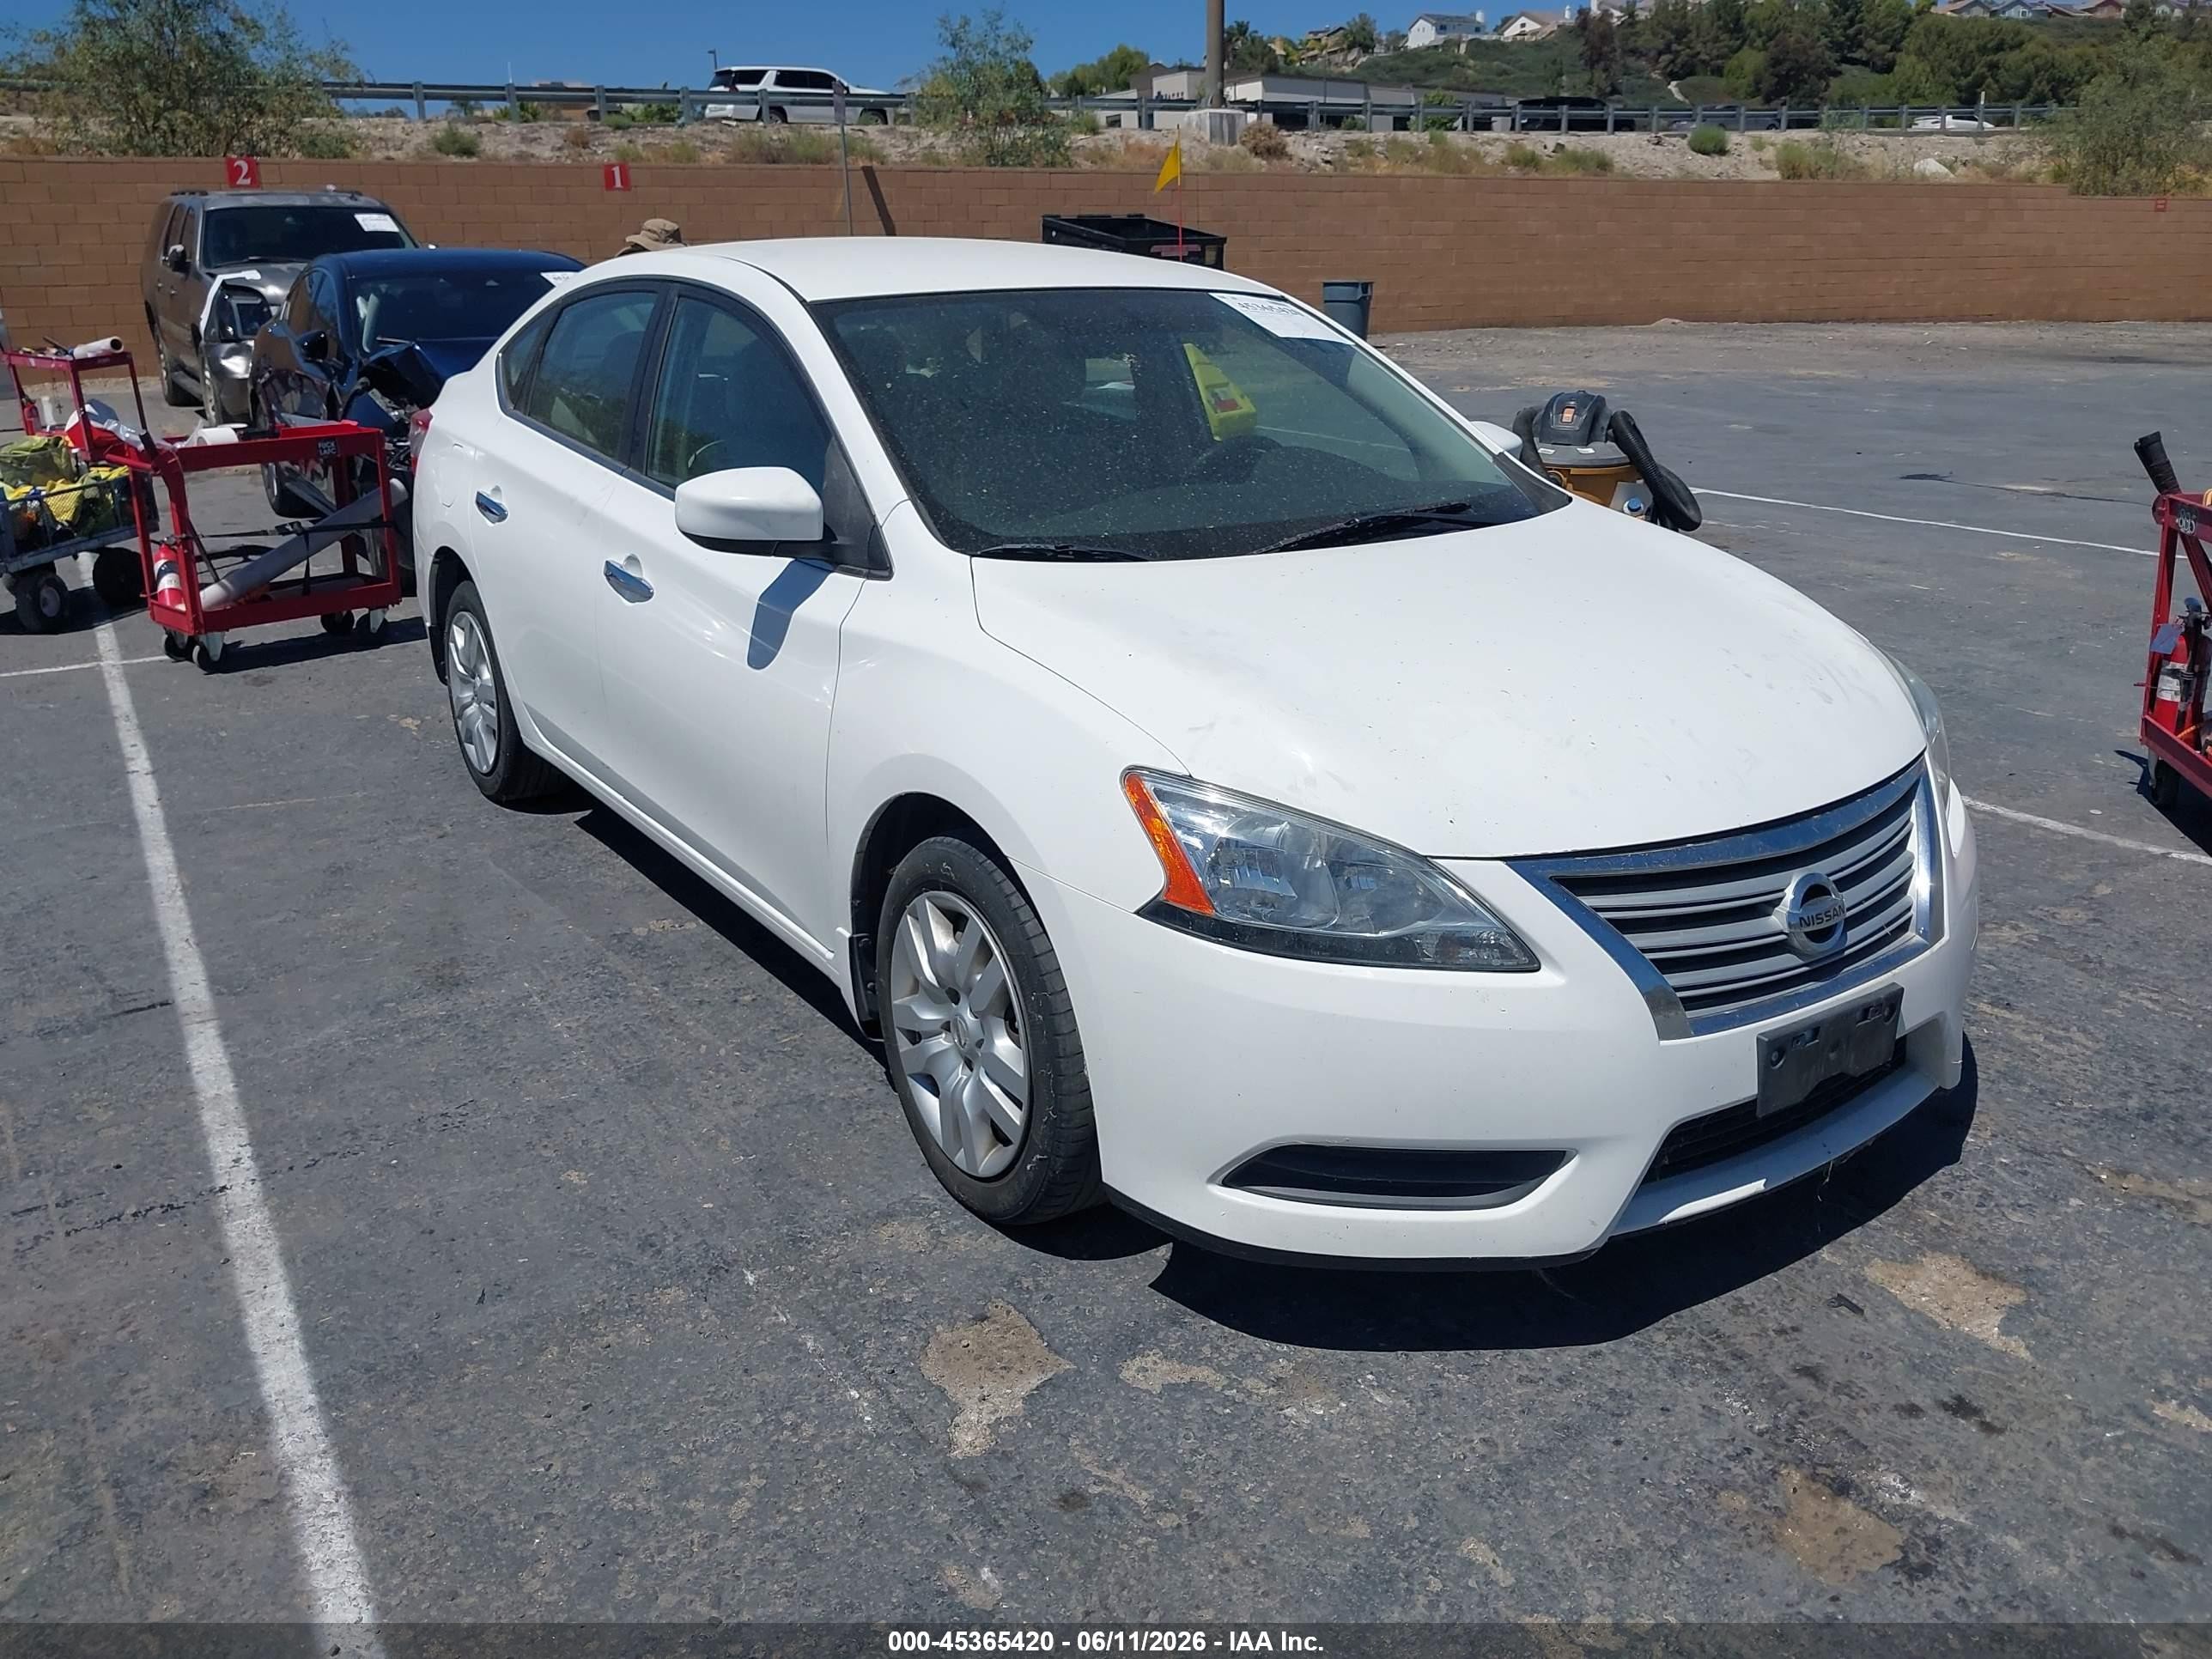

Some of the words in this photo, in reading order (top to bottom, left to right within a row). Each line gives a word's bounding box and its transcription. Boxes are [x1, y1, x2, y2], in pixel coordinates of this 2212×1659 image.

[234, 160, 252, 185] 2
[611, 165, 623, 188] 1
[1799, 905, 1844, 928] NISSAN
